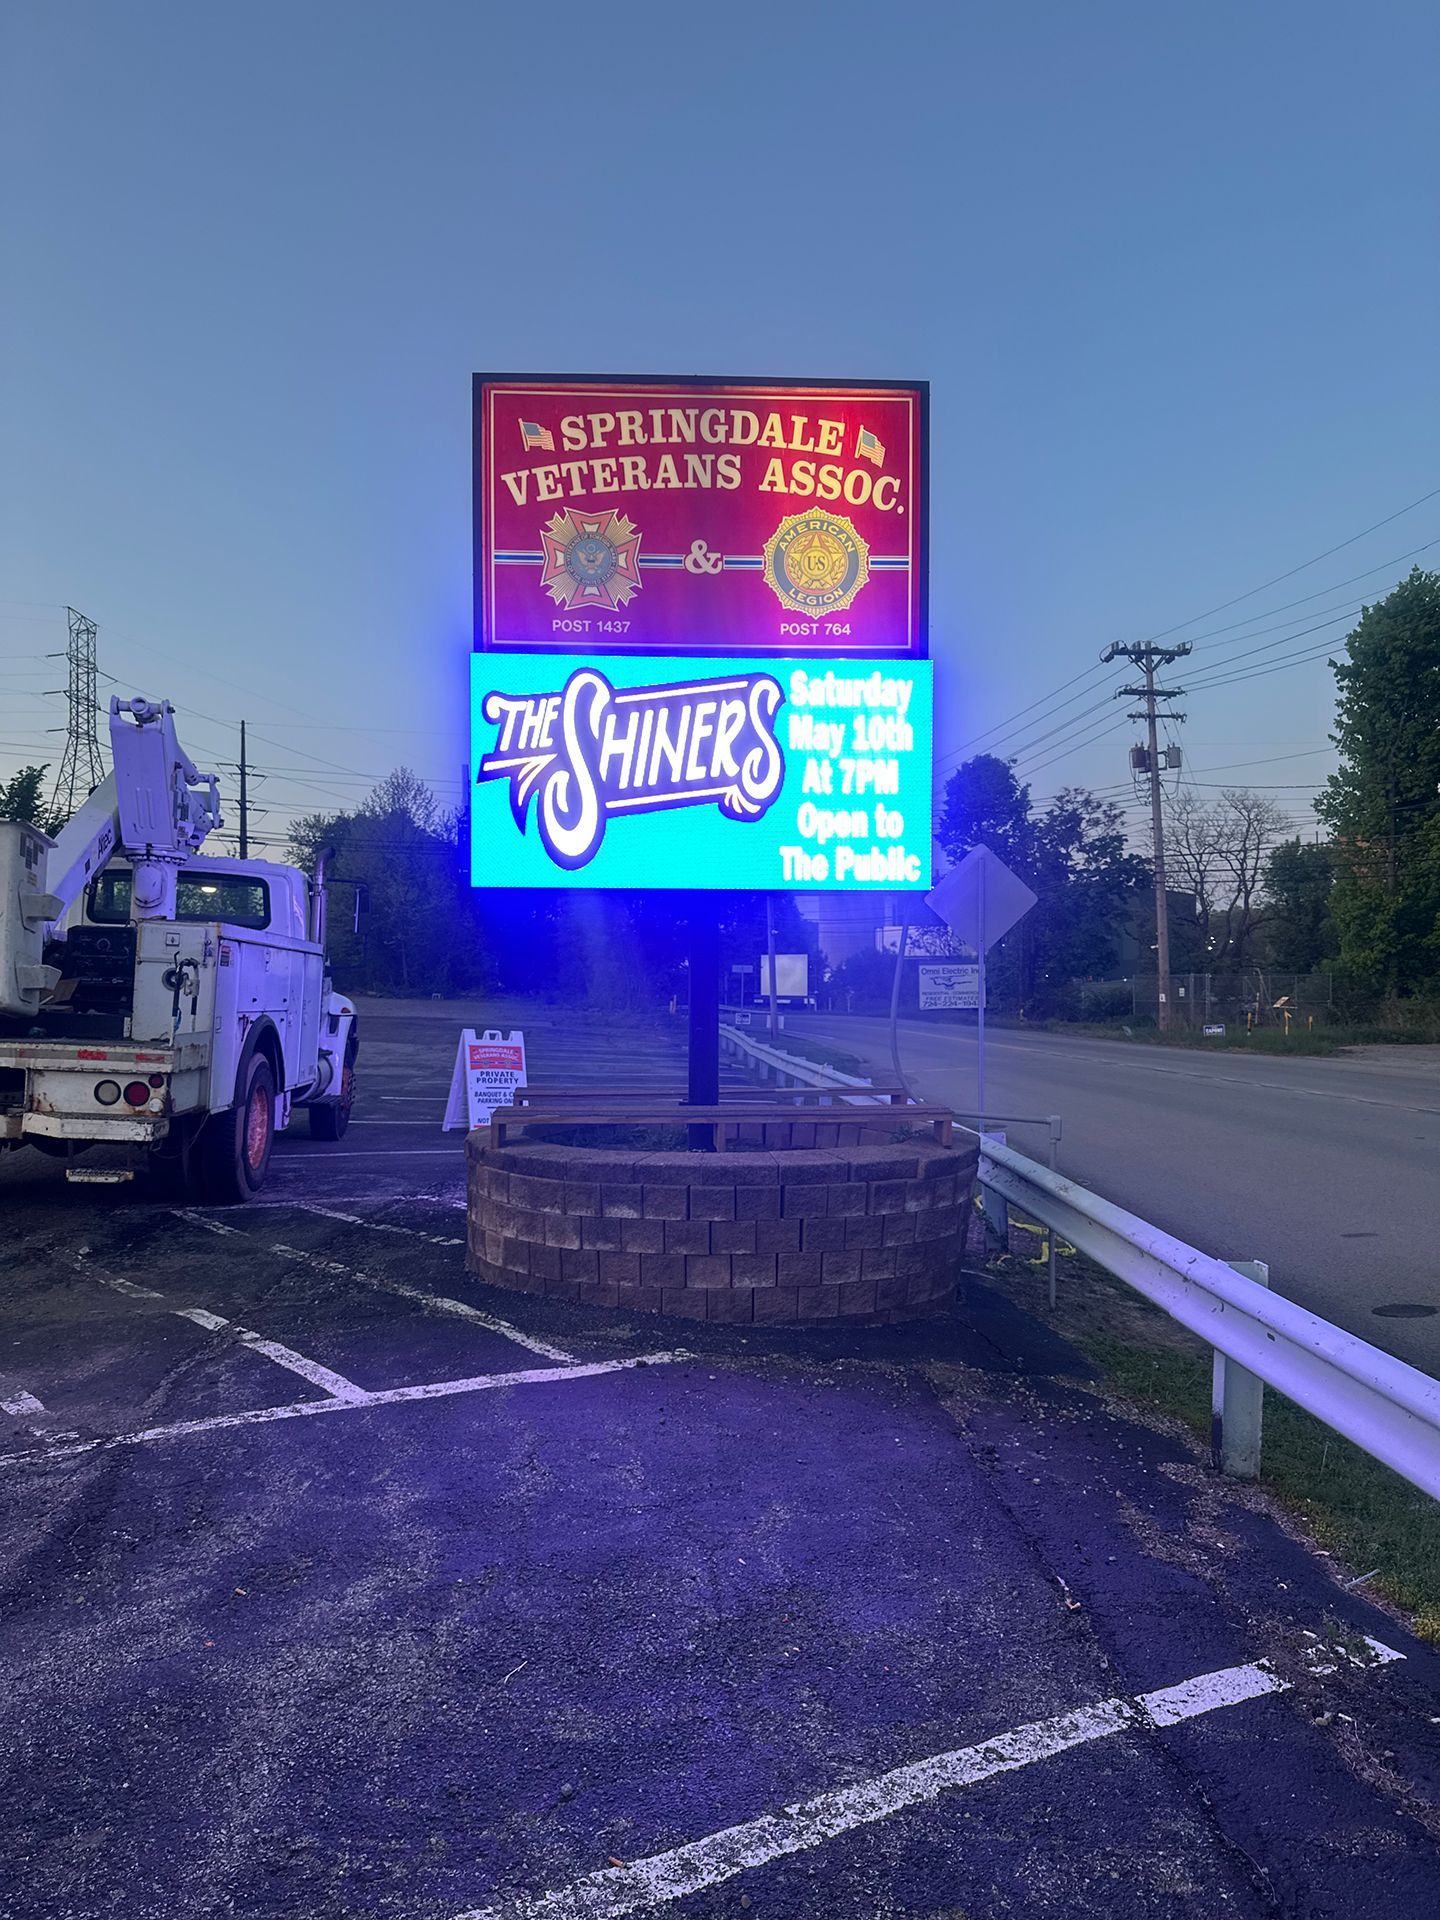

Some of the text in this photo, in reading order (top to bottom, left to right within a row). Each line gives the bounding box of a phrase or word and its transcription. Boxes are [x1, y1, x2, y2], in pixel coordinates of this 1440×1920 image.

[562, 408, 845, 457] SPRINGDALE
[501, 454, 905, 515] VETERANS ASSOC.
[779, 521, 856, 553] AMERICAN
[684, 540, 723, 574] &
[789, 588, 844, 605] LEGION
[552, 620, 631, 634] POST 1437
[780, 623, 851, 636] POST 764
[790, 670, 914, 715] Saturday
[486, 695, 562, 752] THE
[790, 714, 914, 757] May 10th
[541, 672, 783, 857] SHINERS
[802, 758, 899, 795] At 7PM
[797, 803, 905, 844] Open to
[97, 828, 112, 860] Altec
[779, 846, 921, 883] The Public
[921, 967, 940, 975] Omni
[942, 967, 969, 975] Electric
